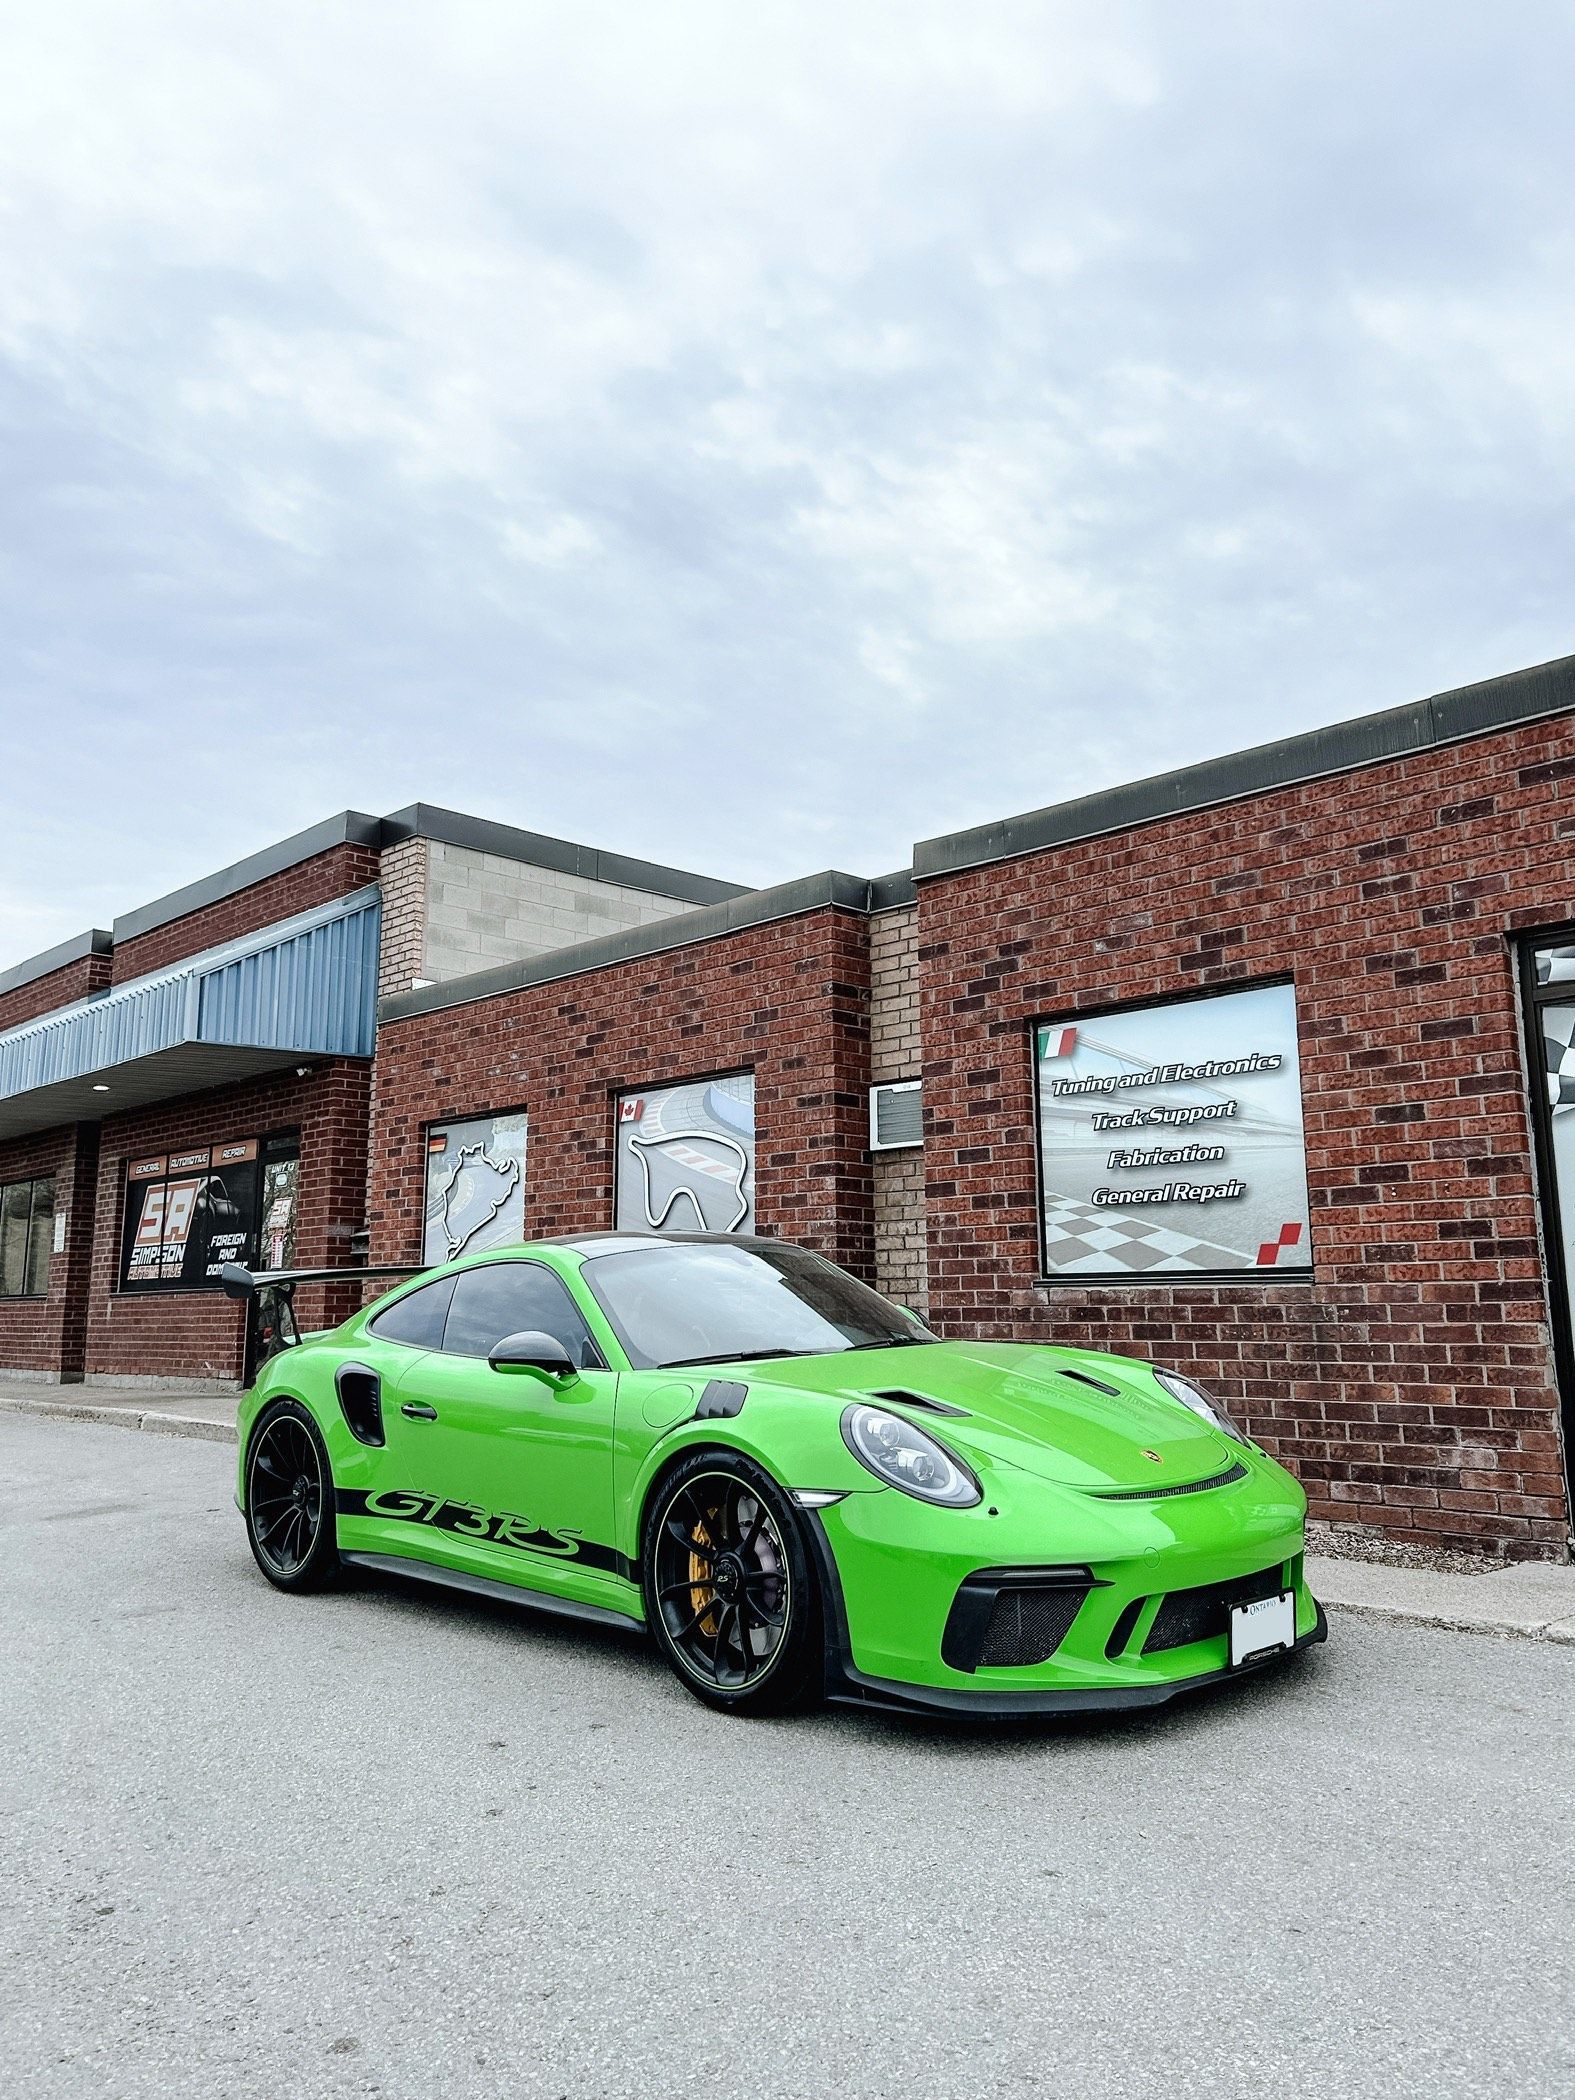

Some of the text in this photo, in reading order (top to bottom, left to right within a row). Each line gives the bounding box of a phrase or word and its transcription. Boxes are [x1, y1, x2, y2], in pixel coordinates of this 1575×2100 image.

[1052, 1053, 1282, 1097] Tuning and Electronics
[1092, 1100, 1237, 1131] Track Support
[135, 1145, 246, 1175] GENERAL AUTOMOTIVE REPAIR
[1107, 1144, 1225, 1169] Fabrication
[1092, 1179, 1246, 1205] General Repair
[140, 1187, 195, 1240] SA
[211, 1233, 247, 1247] FOREIGN
[129, 1244, 186, 1265] SIMPSON
[218, 1248, 237, 1260] AND
